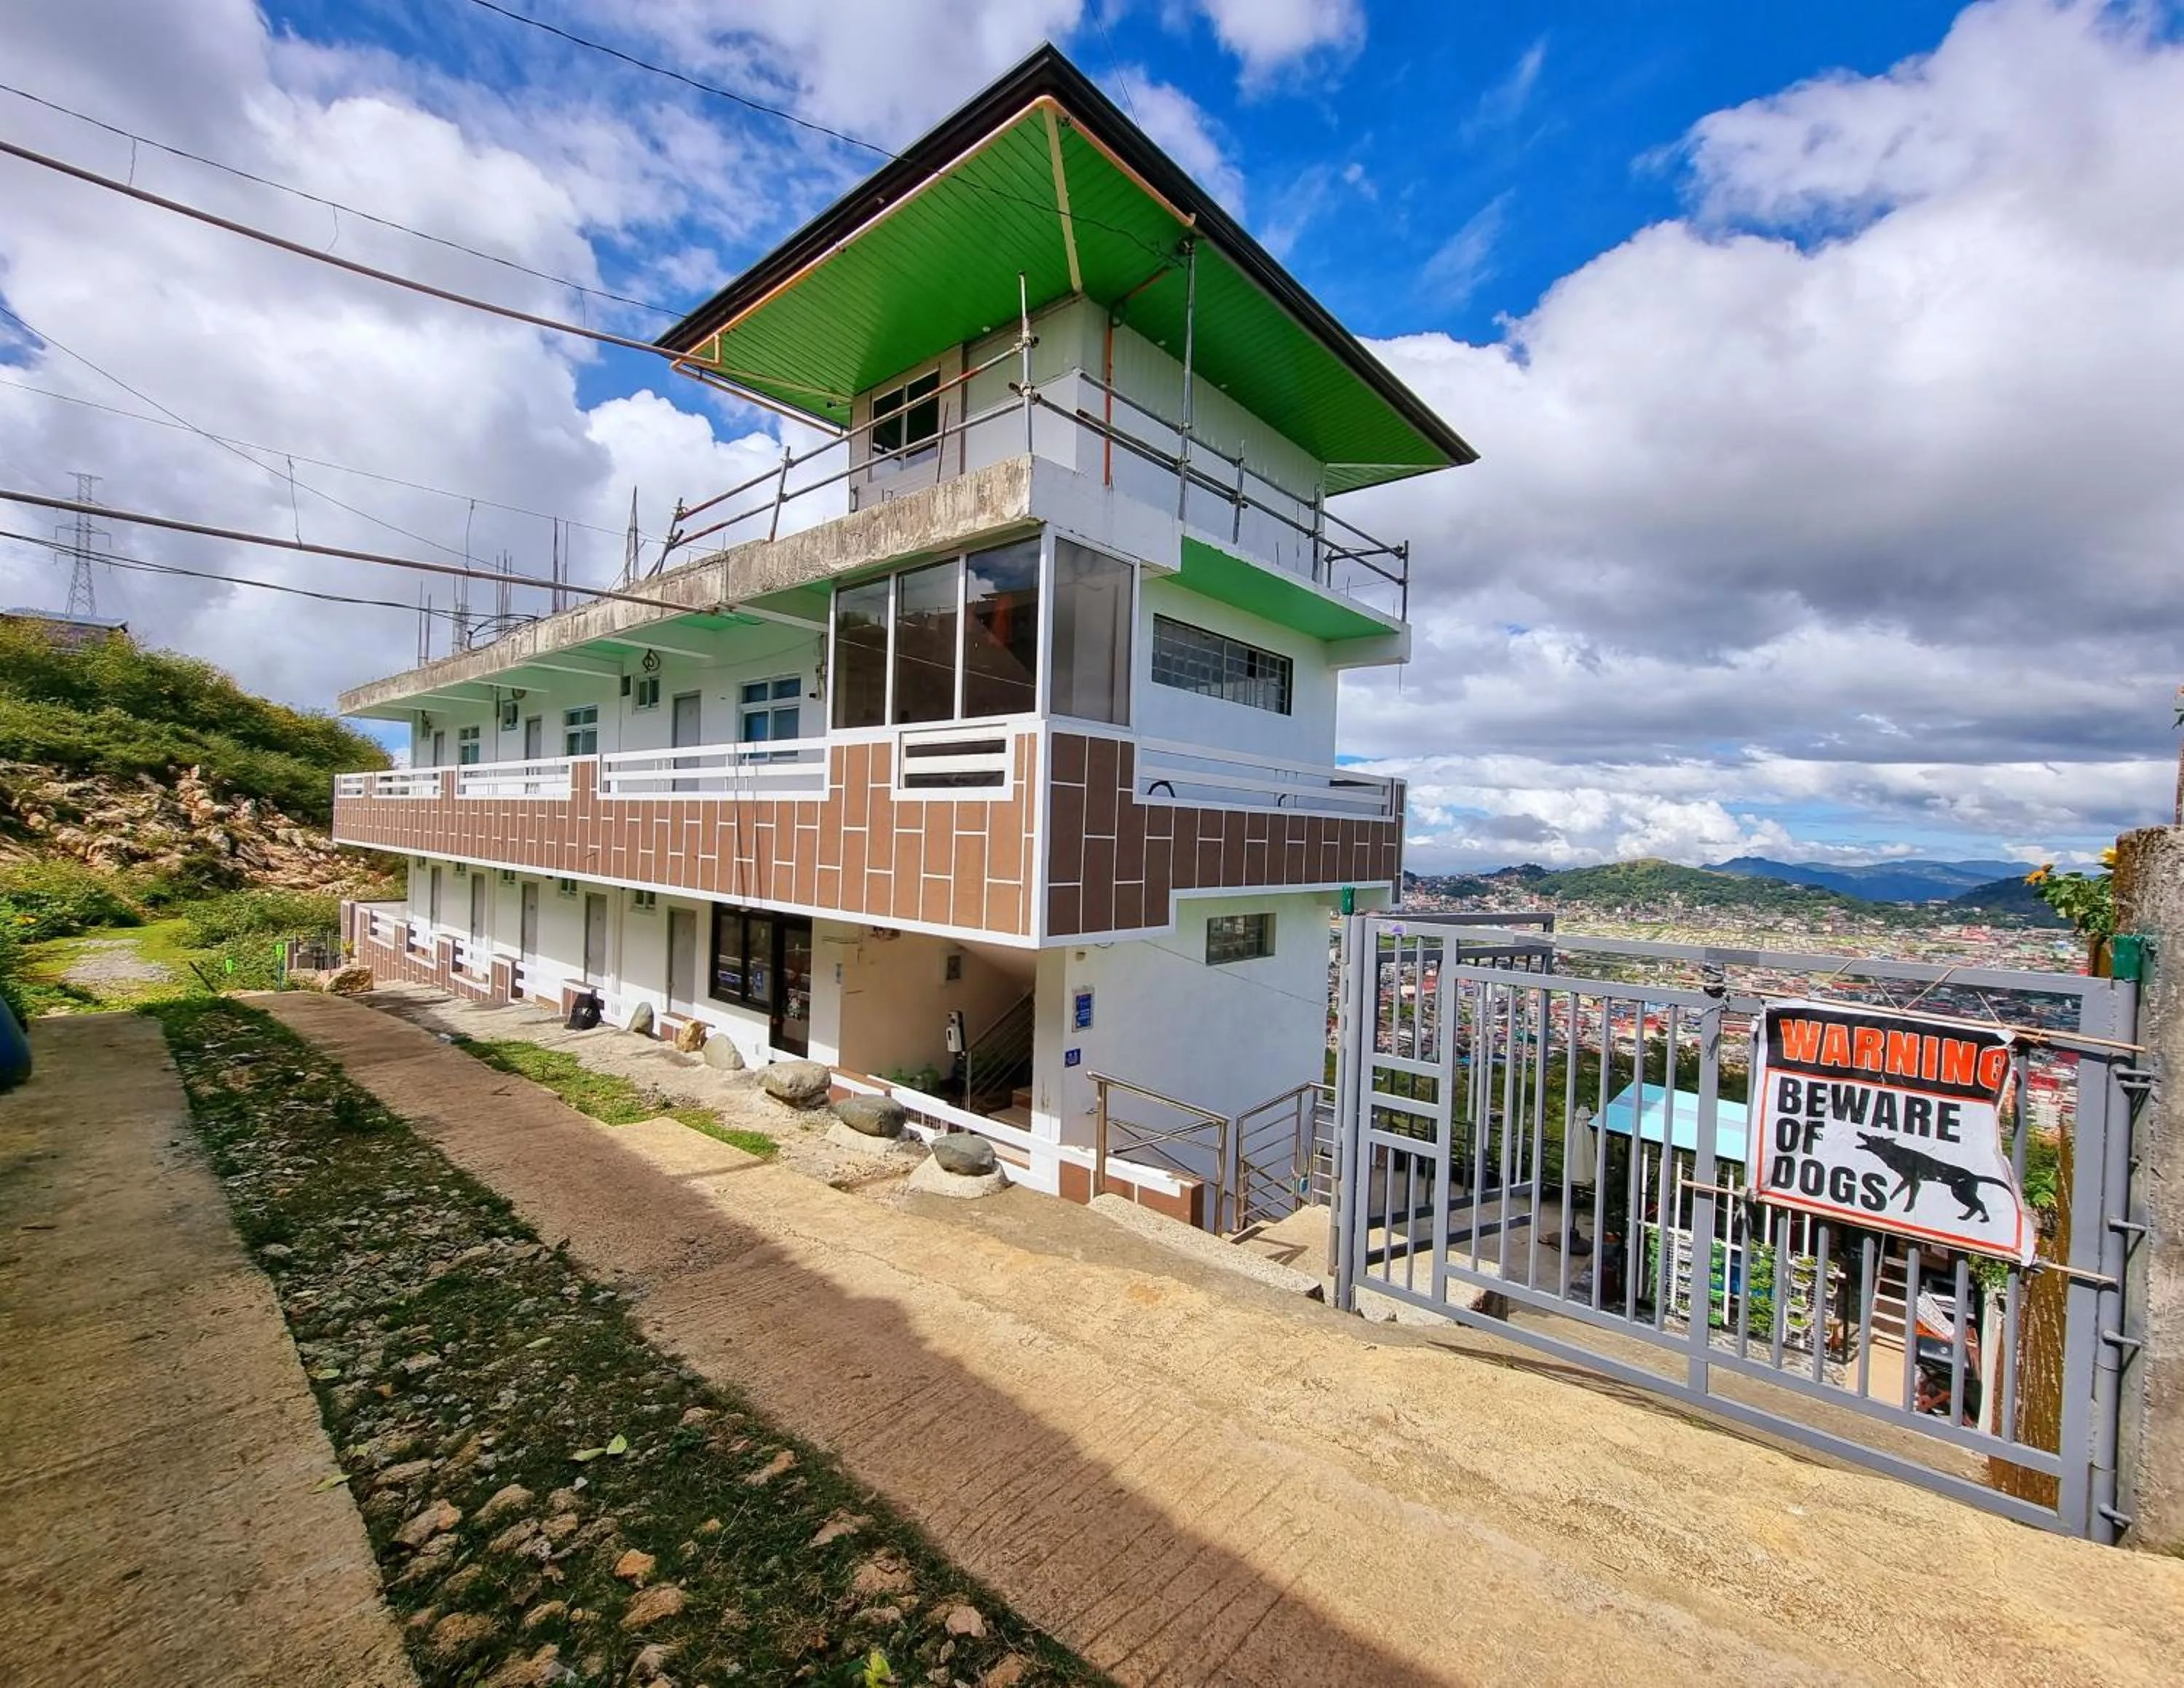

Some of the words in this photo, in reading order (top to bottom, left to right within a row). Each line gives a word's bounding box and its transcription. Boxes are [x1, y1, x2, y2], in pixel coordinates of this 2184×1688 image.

[1779, 1019, 2010, 1091] WARNING
[1776, 1118, 1825, 1156] OF
[1777, 1076, 1961, 1144] BEWARE
[1771, 1156, 1888, 1212] DOGS
